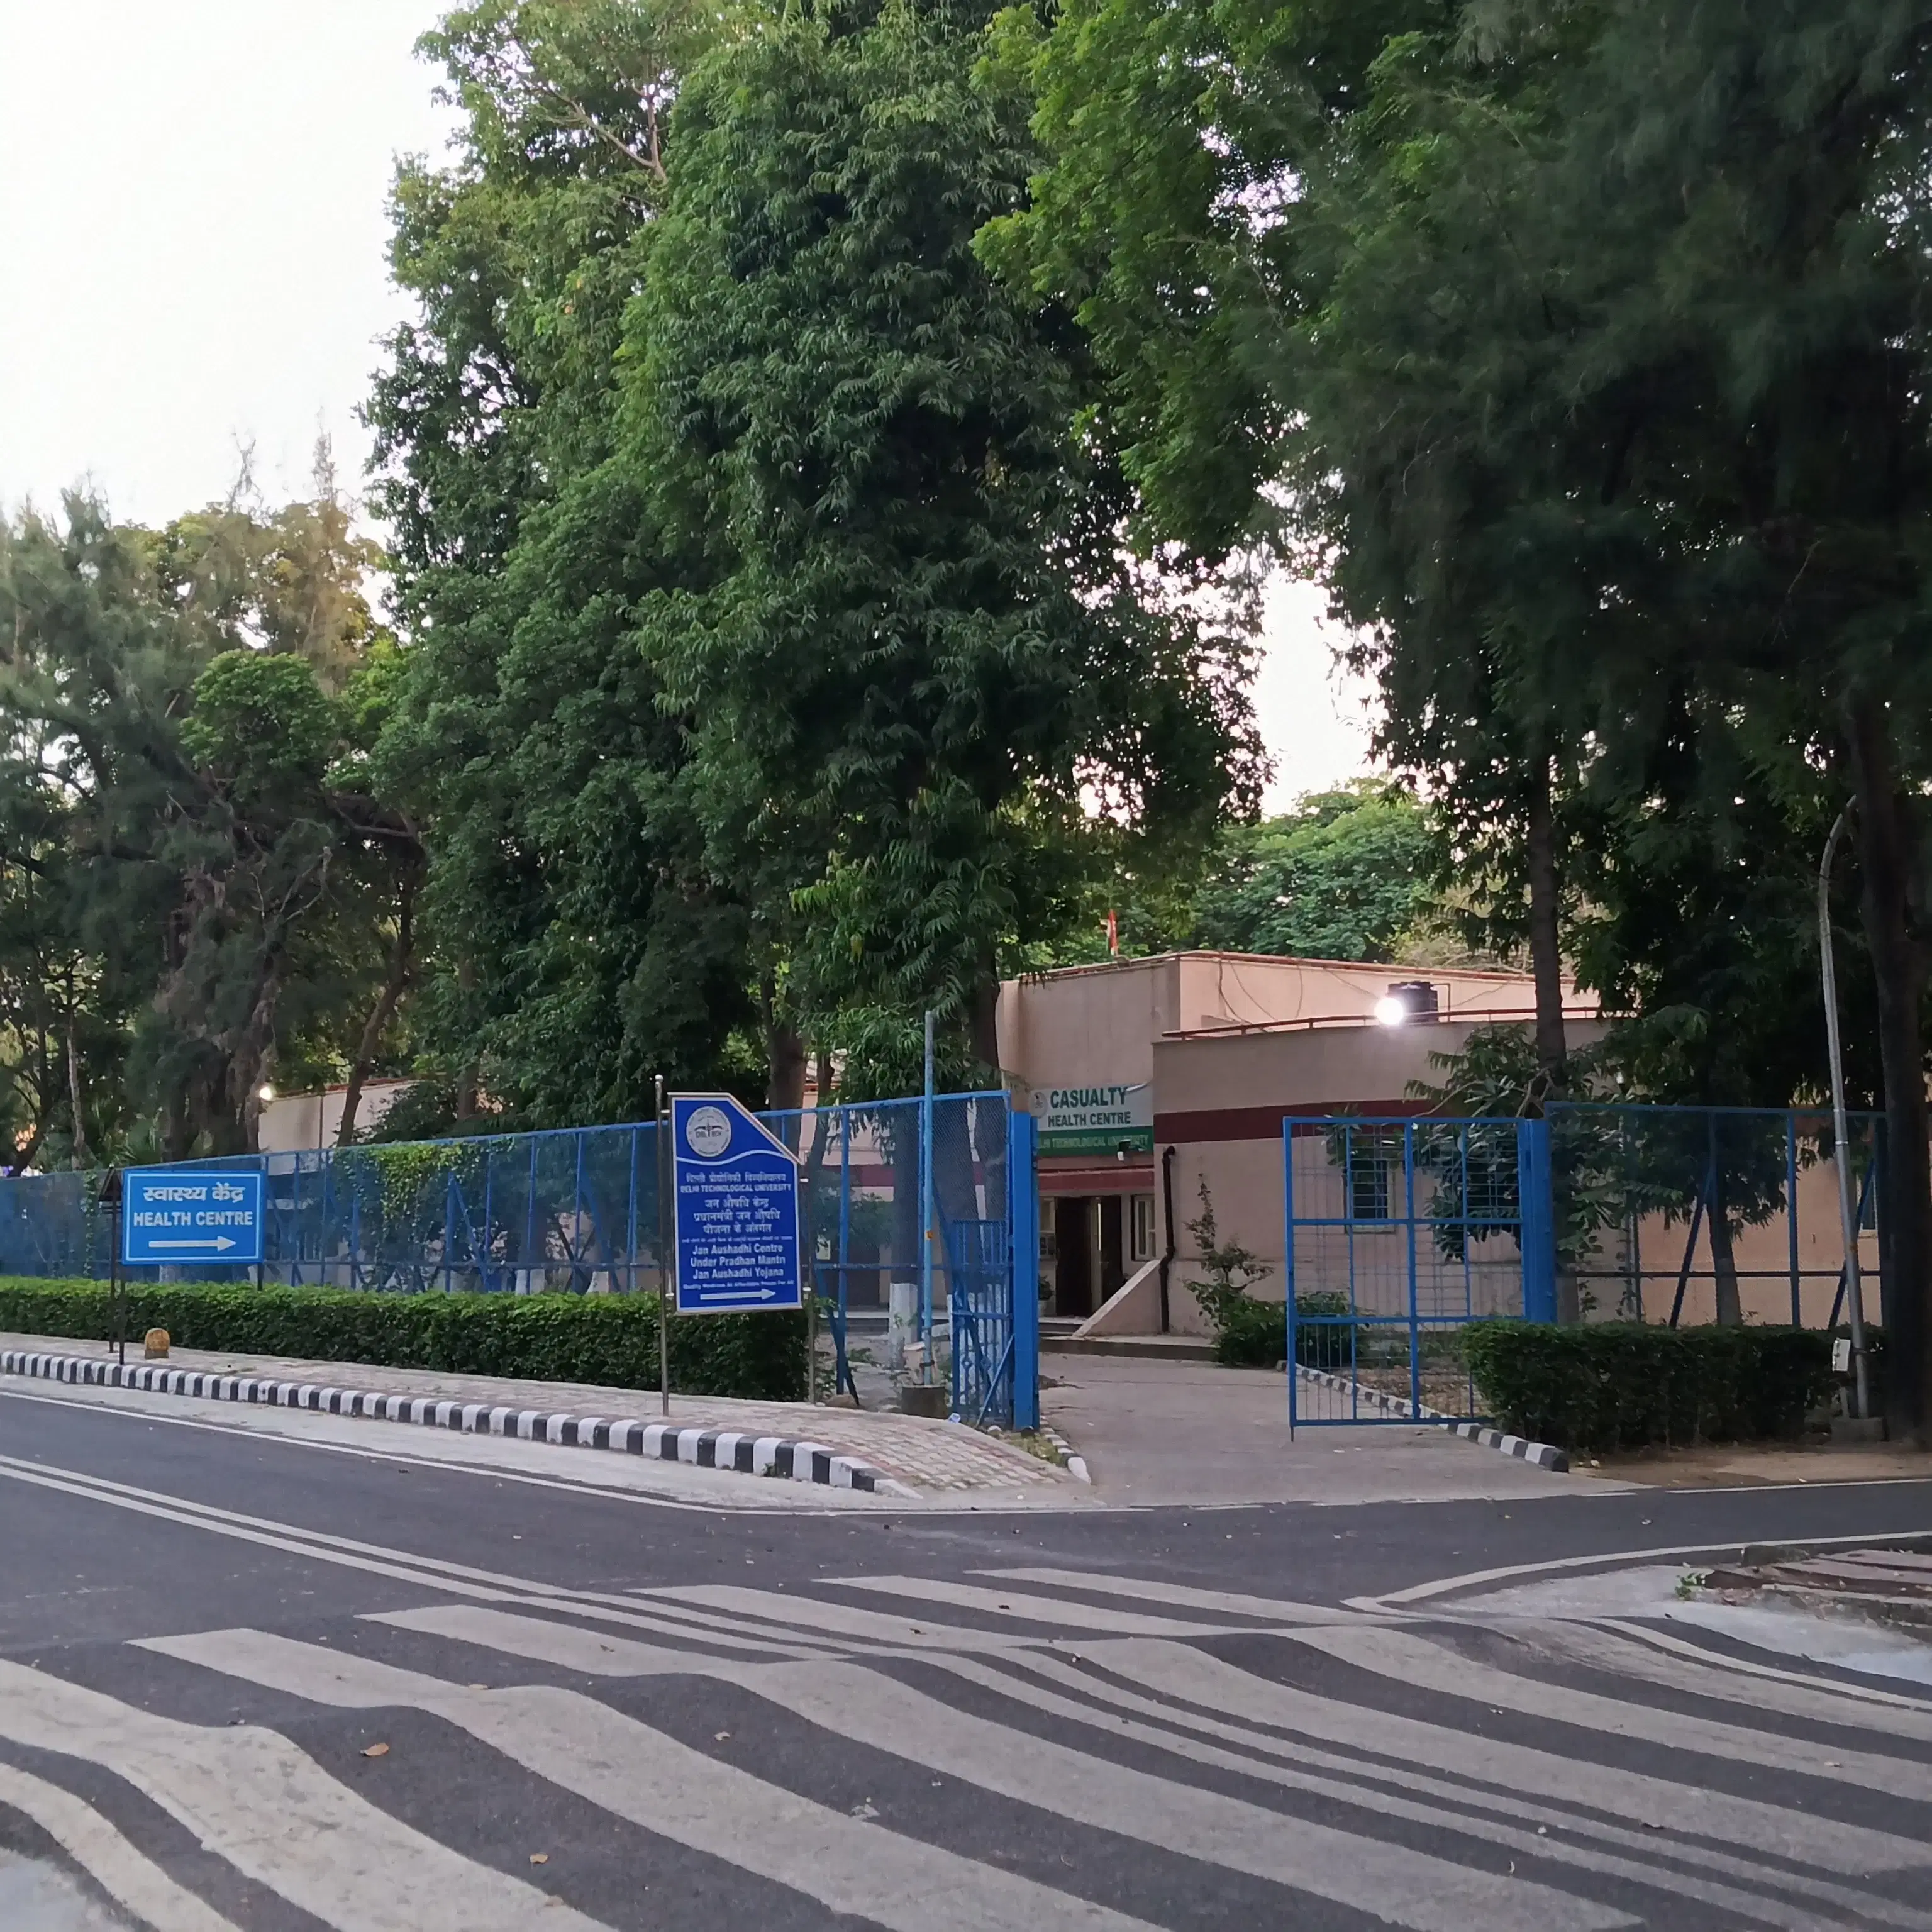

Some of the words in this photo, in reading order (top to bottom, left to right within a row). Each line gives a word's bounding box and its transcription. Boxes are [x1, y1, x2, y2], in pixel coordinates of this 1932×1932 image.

[1050, 1087, 1128, 1108] CASUALTY
[1048, 1114, 1087, 1128] HEALTH
[1089, 1111, 1131, 1125] CENTRE
[143, 1187, 208, 1201] स्वास्थ्य
[212, 1182, 246, 1203] केंद्र
[701, 1184, 753, 1193] TECHNOLOGICAL
[754, 1184, 791, 1192] UNIVERSITY
[704, 1199, 719, 1209] जन
[133, 1211, 191, 1226] HEALTH
[196, 1211, 253, 1226] CENTRE
[694, 1209, 733, 1222] प्रधानमंत्री
[736, 1211, 751, 1221] जन
[702, 1223, 731, 1234] योजना
[692, 1246, 709, 1255] Jan
[711, 1243, 752, 1255] Aushadhi
[754, 1243, 783, 1253] Centre
[690, 1257, 717, 1267] Under
[719, 1256, 755, 1266] Pradhan
[758, 1255, 786, 1265] Mantri
[692, 1269, 709, 1280] Jan
[711, 1267, 752, 1279] Aushadhi
[755, 1267, 784, 1279] Yojana
